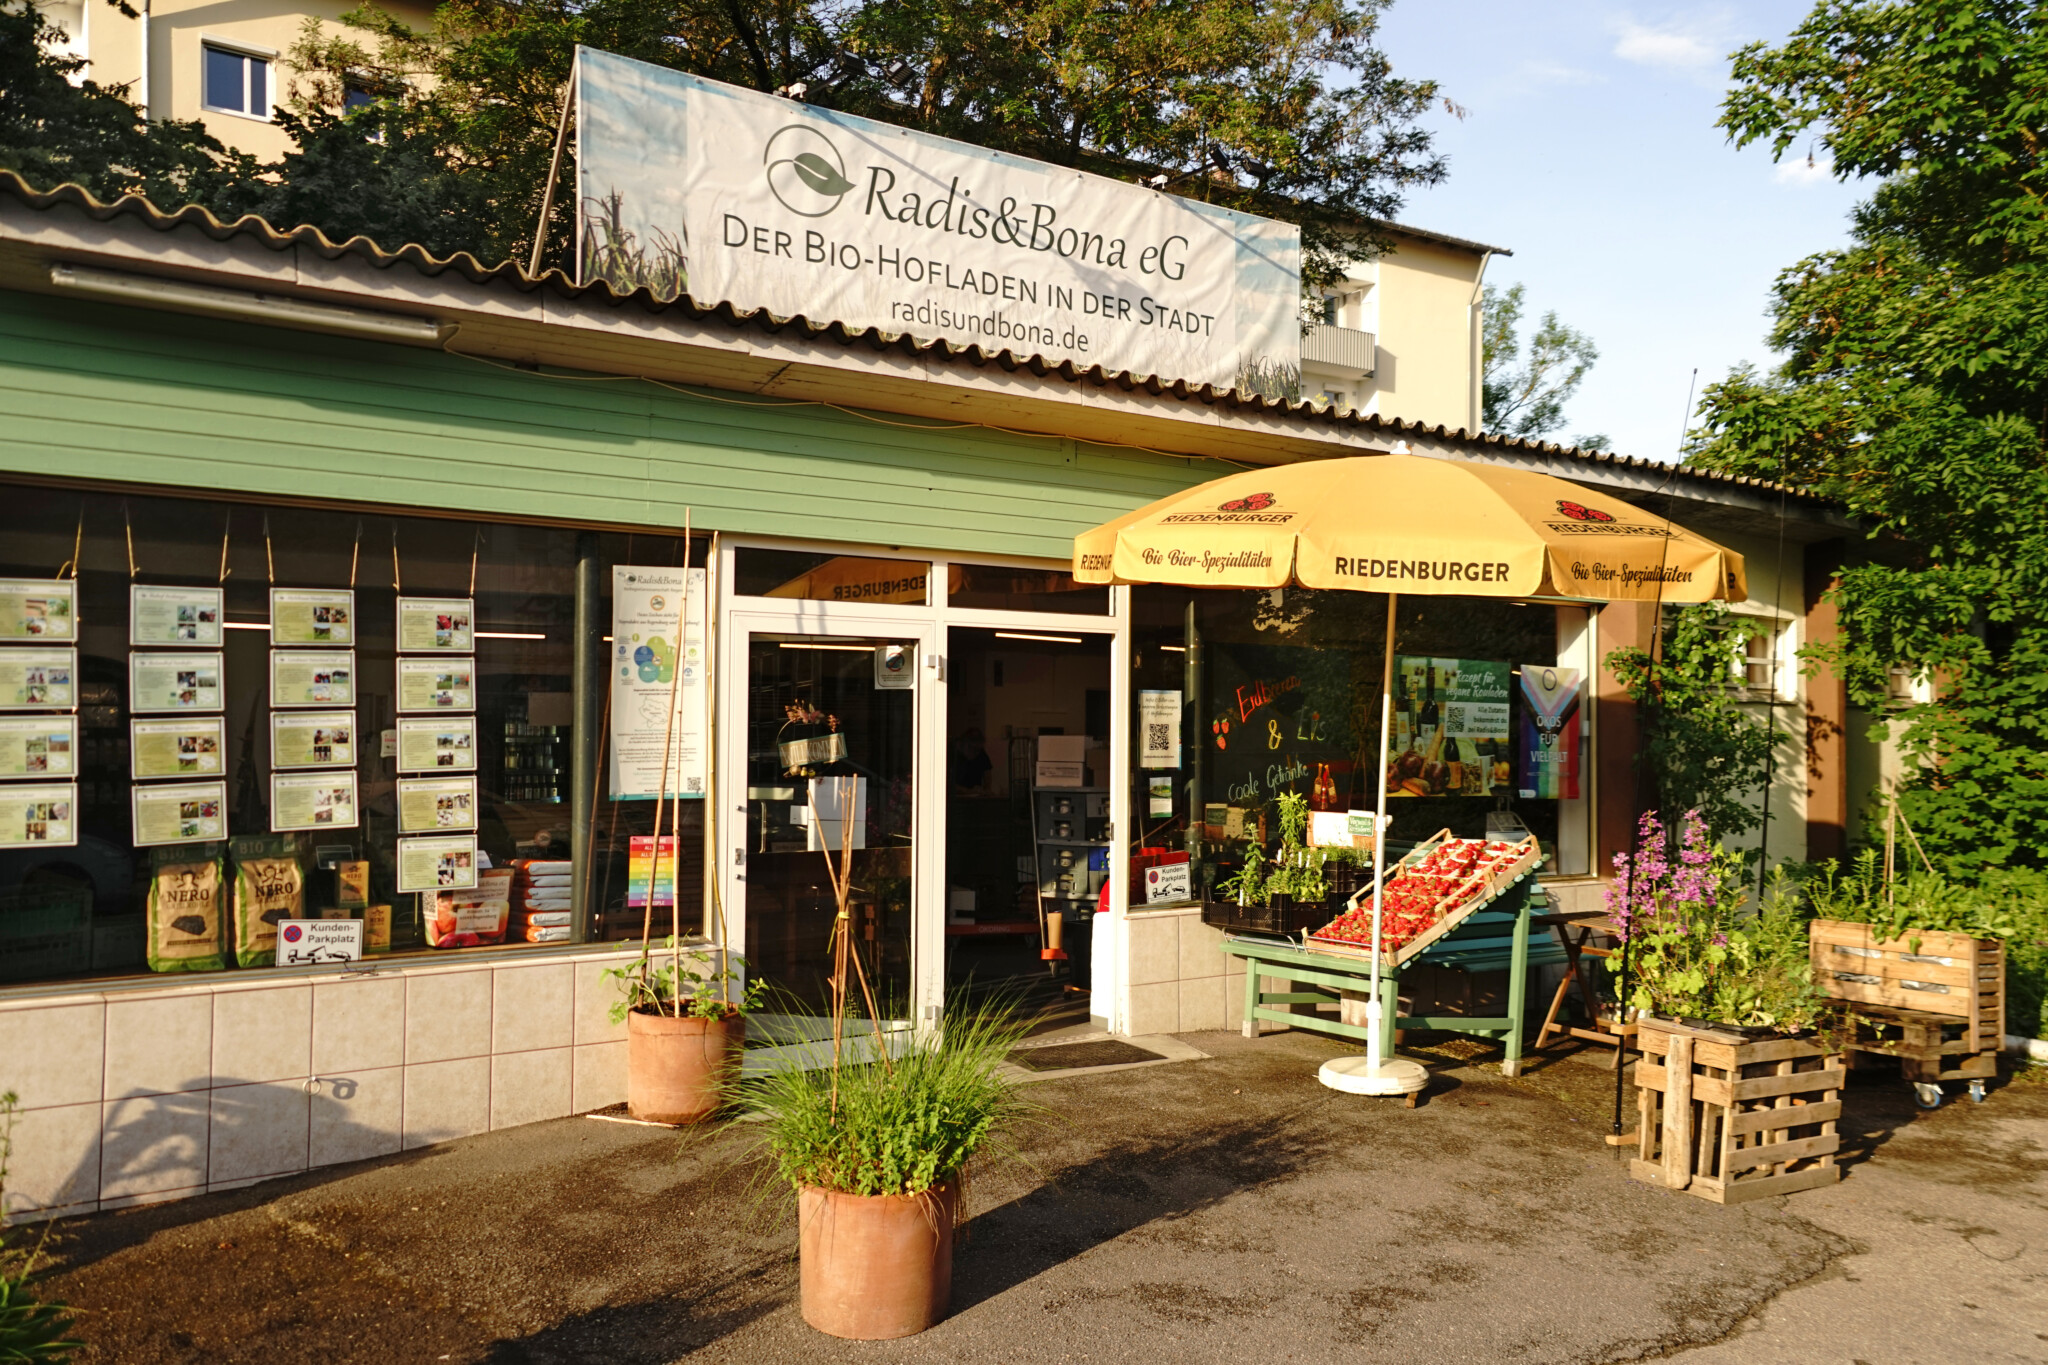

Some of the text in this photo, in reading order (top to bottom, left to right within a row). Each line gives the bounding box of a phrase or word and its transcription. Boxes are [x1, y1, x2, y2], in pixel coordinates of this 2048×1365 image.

[864, 165, 1190, 282] Radis&Bona eG
[890, 297, 1090, 354] radisundbona.de
[1160, 512, 1294, 524] RIEDENBURGER
[1547, 522, 1674, 537] RIEDENBURGER
[1141, 547, 1272, 574] Bio Bier-Spezialitäten
[1335, 556, 1510, 582] RIEDENBURGER
[1571, 561, 1693, 588] Bio Bier-Spezialitäten
[637, 575, 682, 585] Radis&Bona
[1456, 670, 1496, 686] Rezept für
[1446, 684, 1508, 700] vegane Rouladen
[1536, 712, 1561, 727] ÖKOS
[1540, 730, 1558, 745] FÜR
[780, 734, 846, 766] WILLKOMMEN
[1530, 750, 1568, 762] VIELFALT
[239, 841, 264, 854] BIO
[1161, 866, 1185, 876] Kunden-
[1161, 873, 1187, 883] Parkplatz
[167, 888, 210, 903] NERO
[255, 882, 294, 898] NERO
[310, 923, 354, 933] Kunden-
[308, 934, 356, 944] Parkplatz
